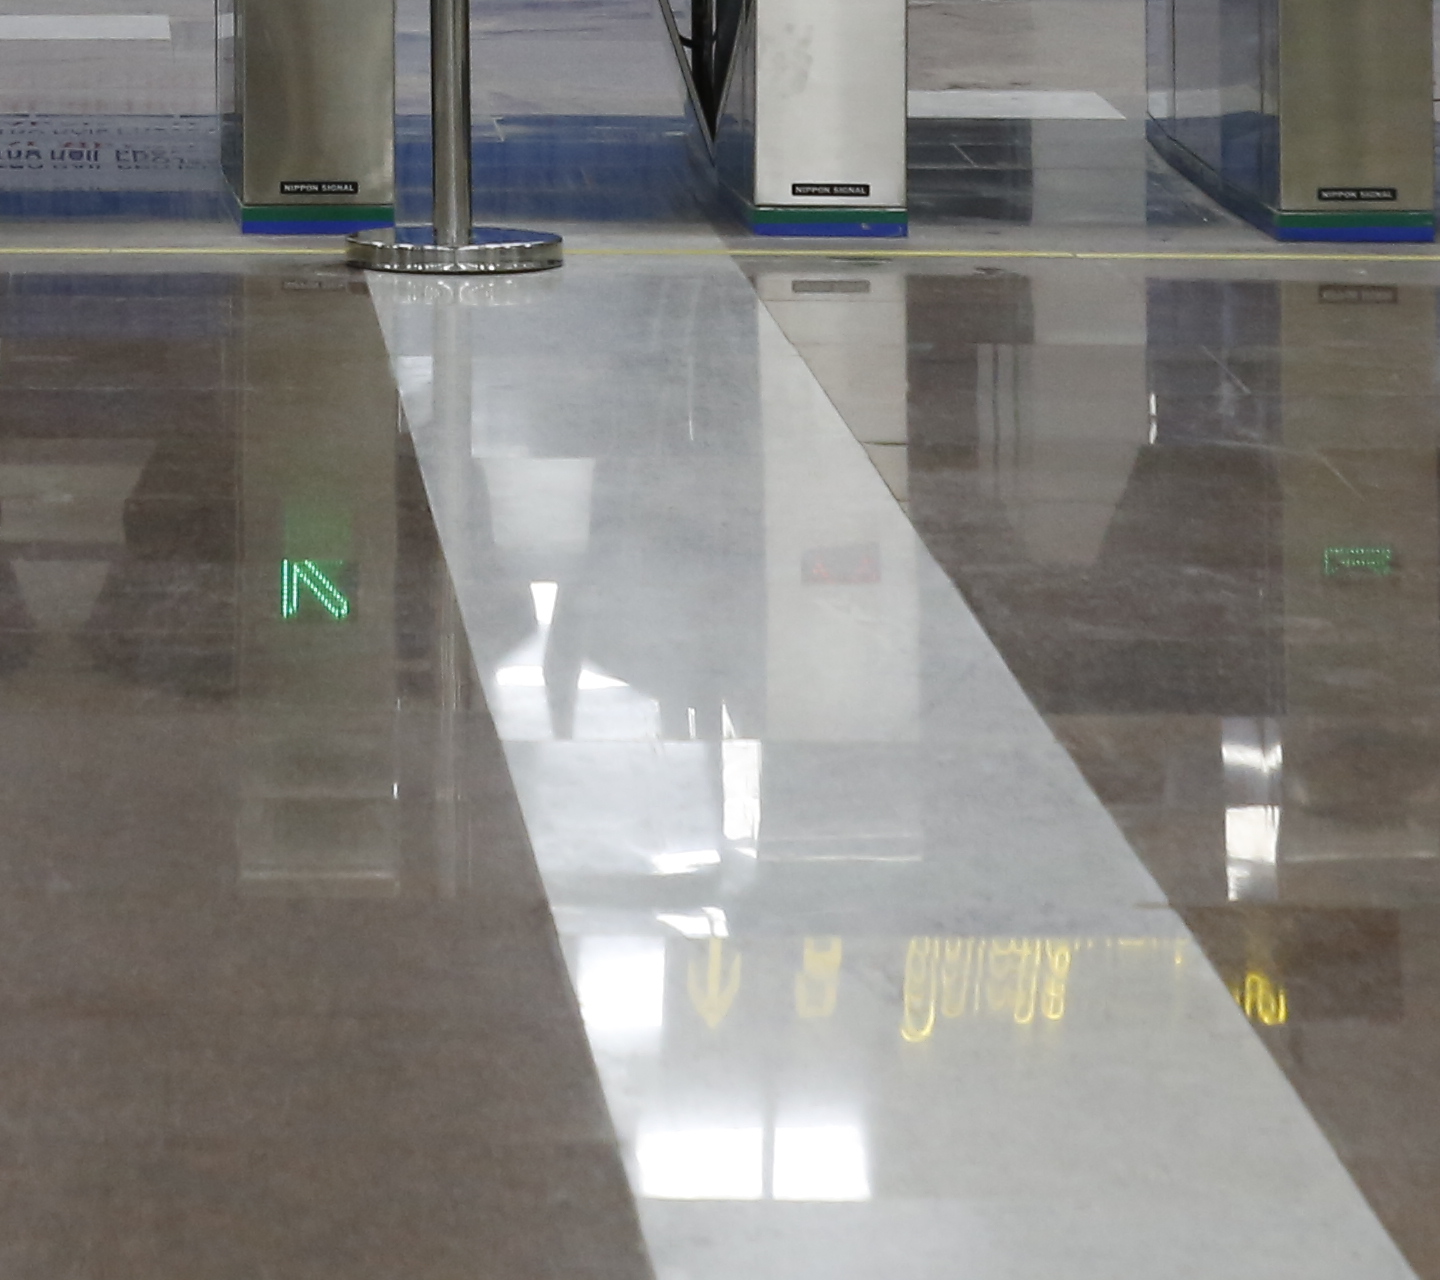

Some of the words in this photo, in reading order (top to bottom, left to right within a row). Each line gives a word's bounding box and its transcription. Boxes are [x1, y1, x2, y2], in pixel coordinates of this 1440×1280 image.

[284, 183, 319, 192] NIPPON
[322, 183, 354, 192] SIGNAL
[795, 186, 830, 194] NIPPON
[833, 186, 867, 194] SIGNAL
